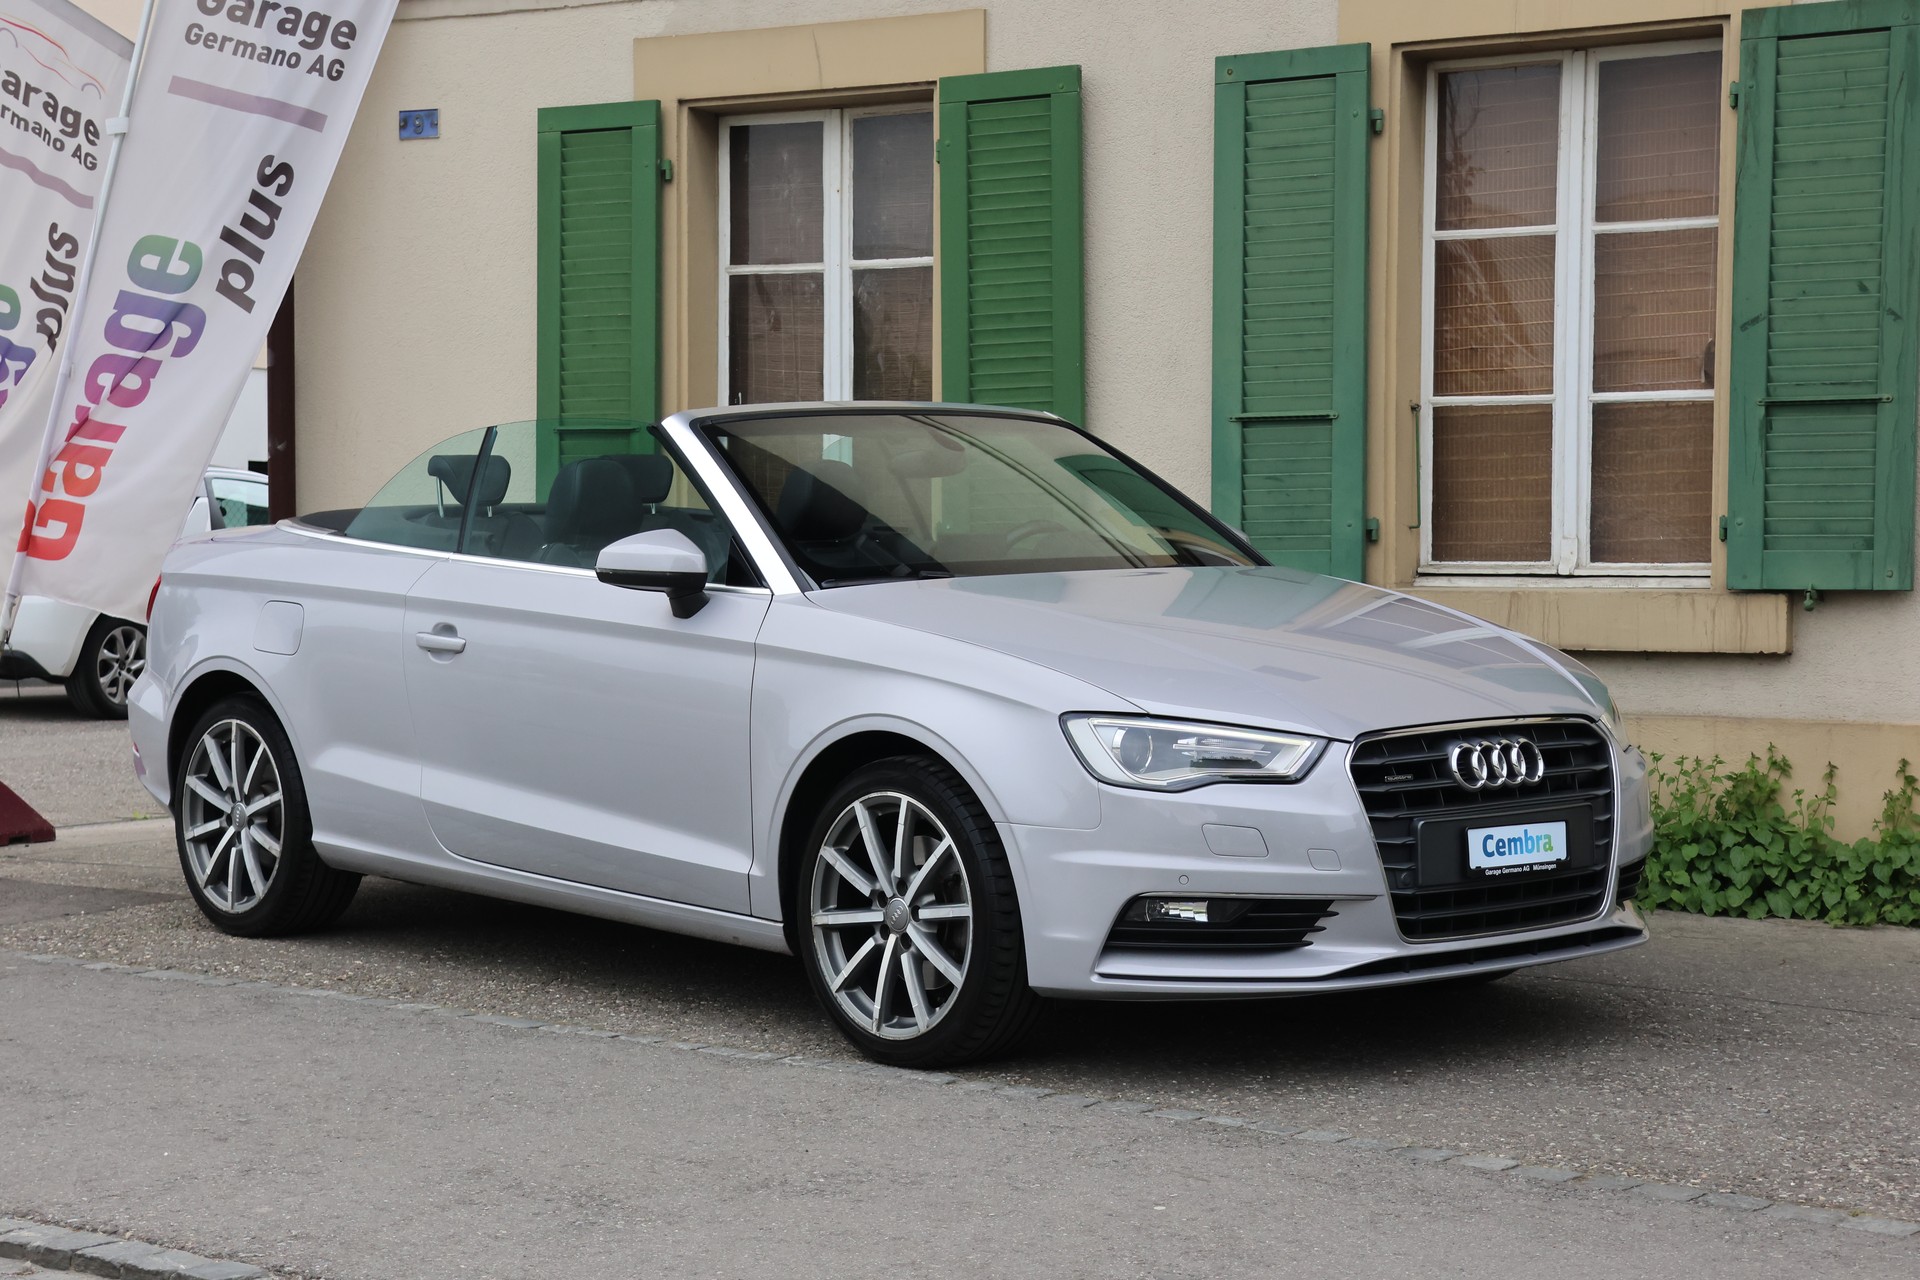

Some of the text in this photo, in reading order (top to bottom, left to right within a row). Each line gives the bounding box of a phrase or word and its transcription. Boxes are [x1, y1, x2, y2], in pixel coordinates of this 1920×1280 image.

[184, 22, 346, 82] Germano AG
[0, 69, 101, 147] arage
[0, 103, 98, 171] rmano AG
[215, 154, 295, 314] plus
[30, 221, 80, 356] plus
[16, 234, 207, 561] Garage
[1482, 829, 1553, 857] Cembra
